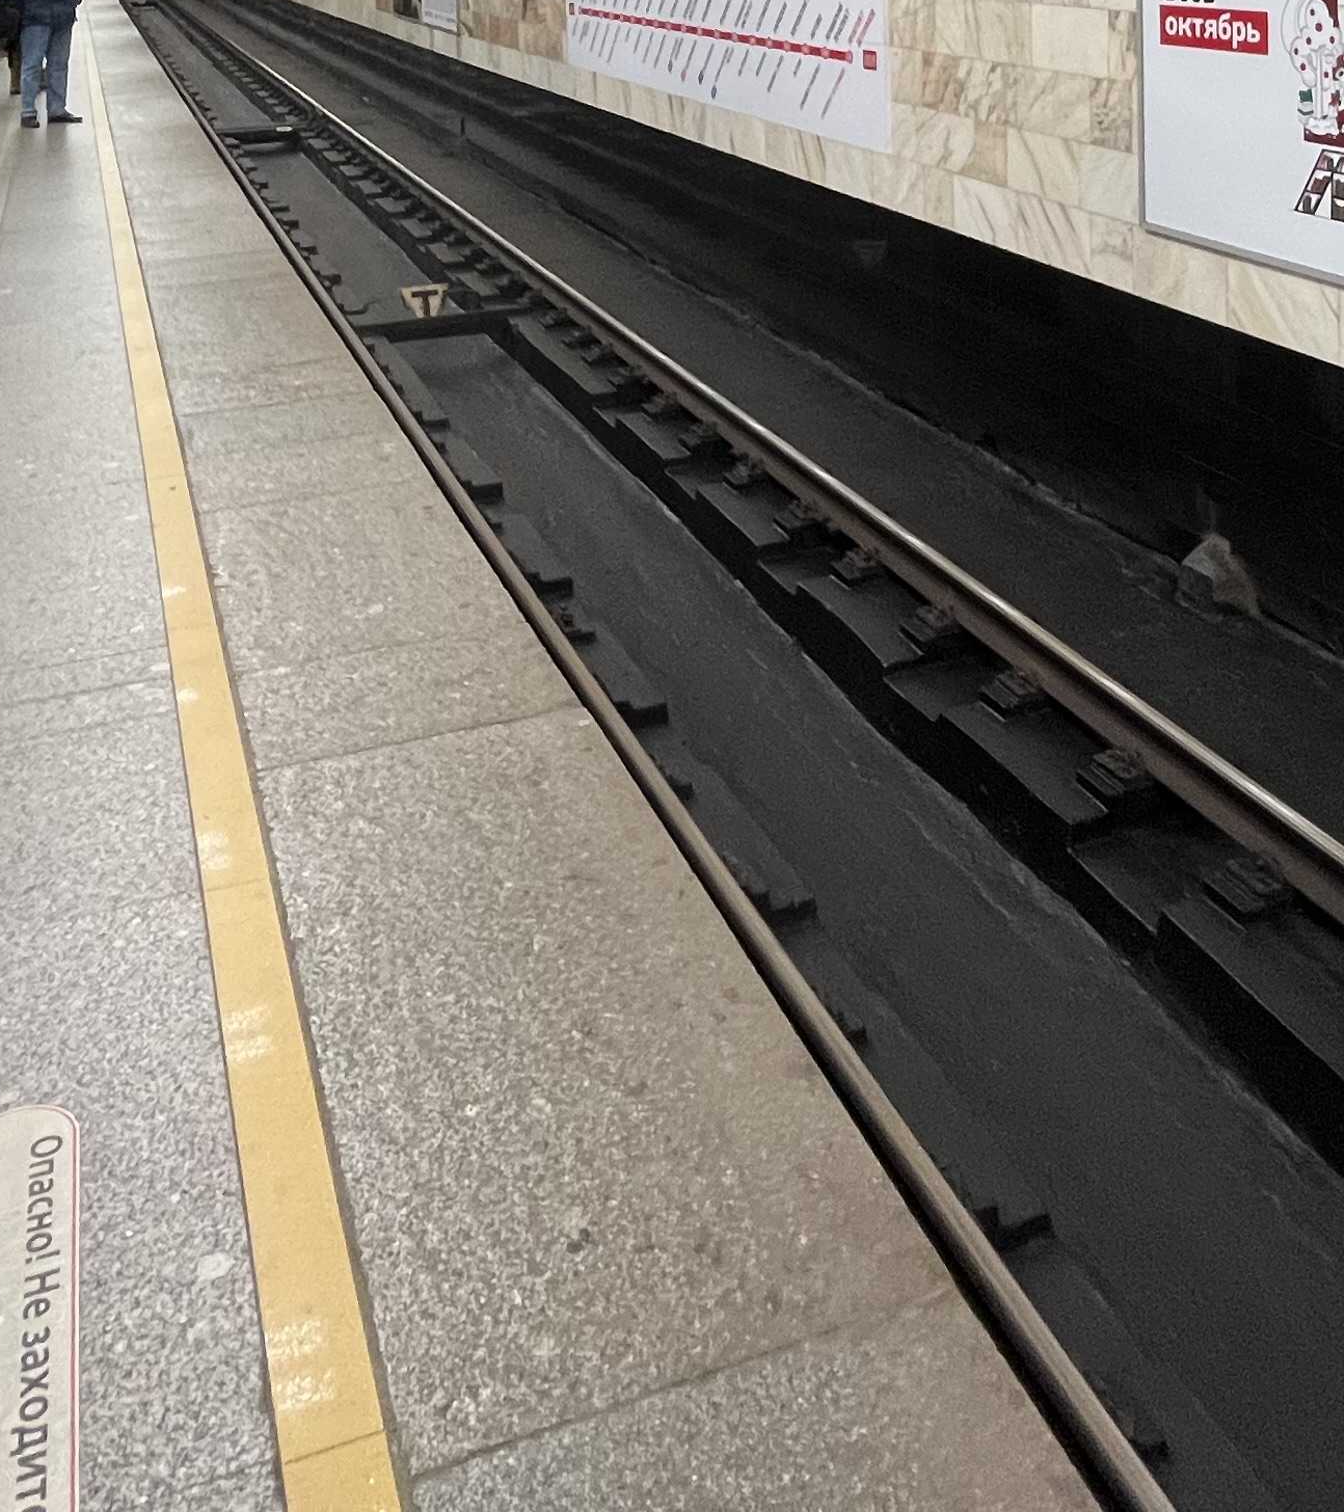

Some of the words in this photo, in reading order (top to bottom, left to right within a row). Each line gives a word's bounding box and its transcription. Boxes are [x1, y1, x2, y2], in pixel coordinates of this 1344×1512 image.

[1164, 12, 1261, 44] октябрь
[24, 1134, 64, 1265] Опасно!
[22, 1267, 60, 1320] Не
[9, 1326, 52, 1512] заходит
